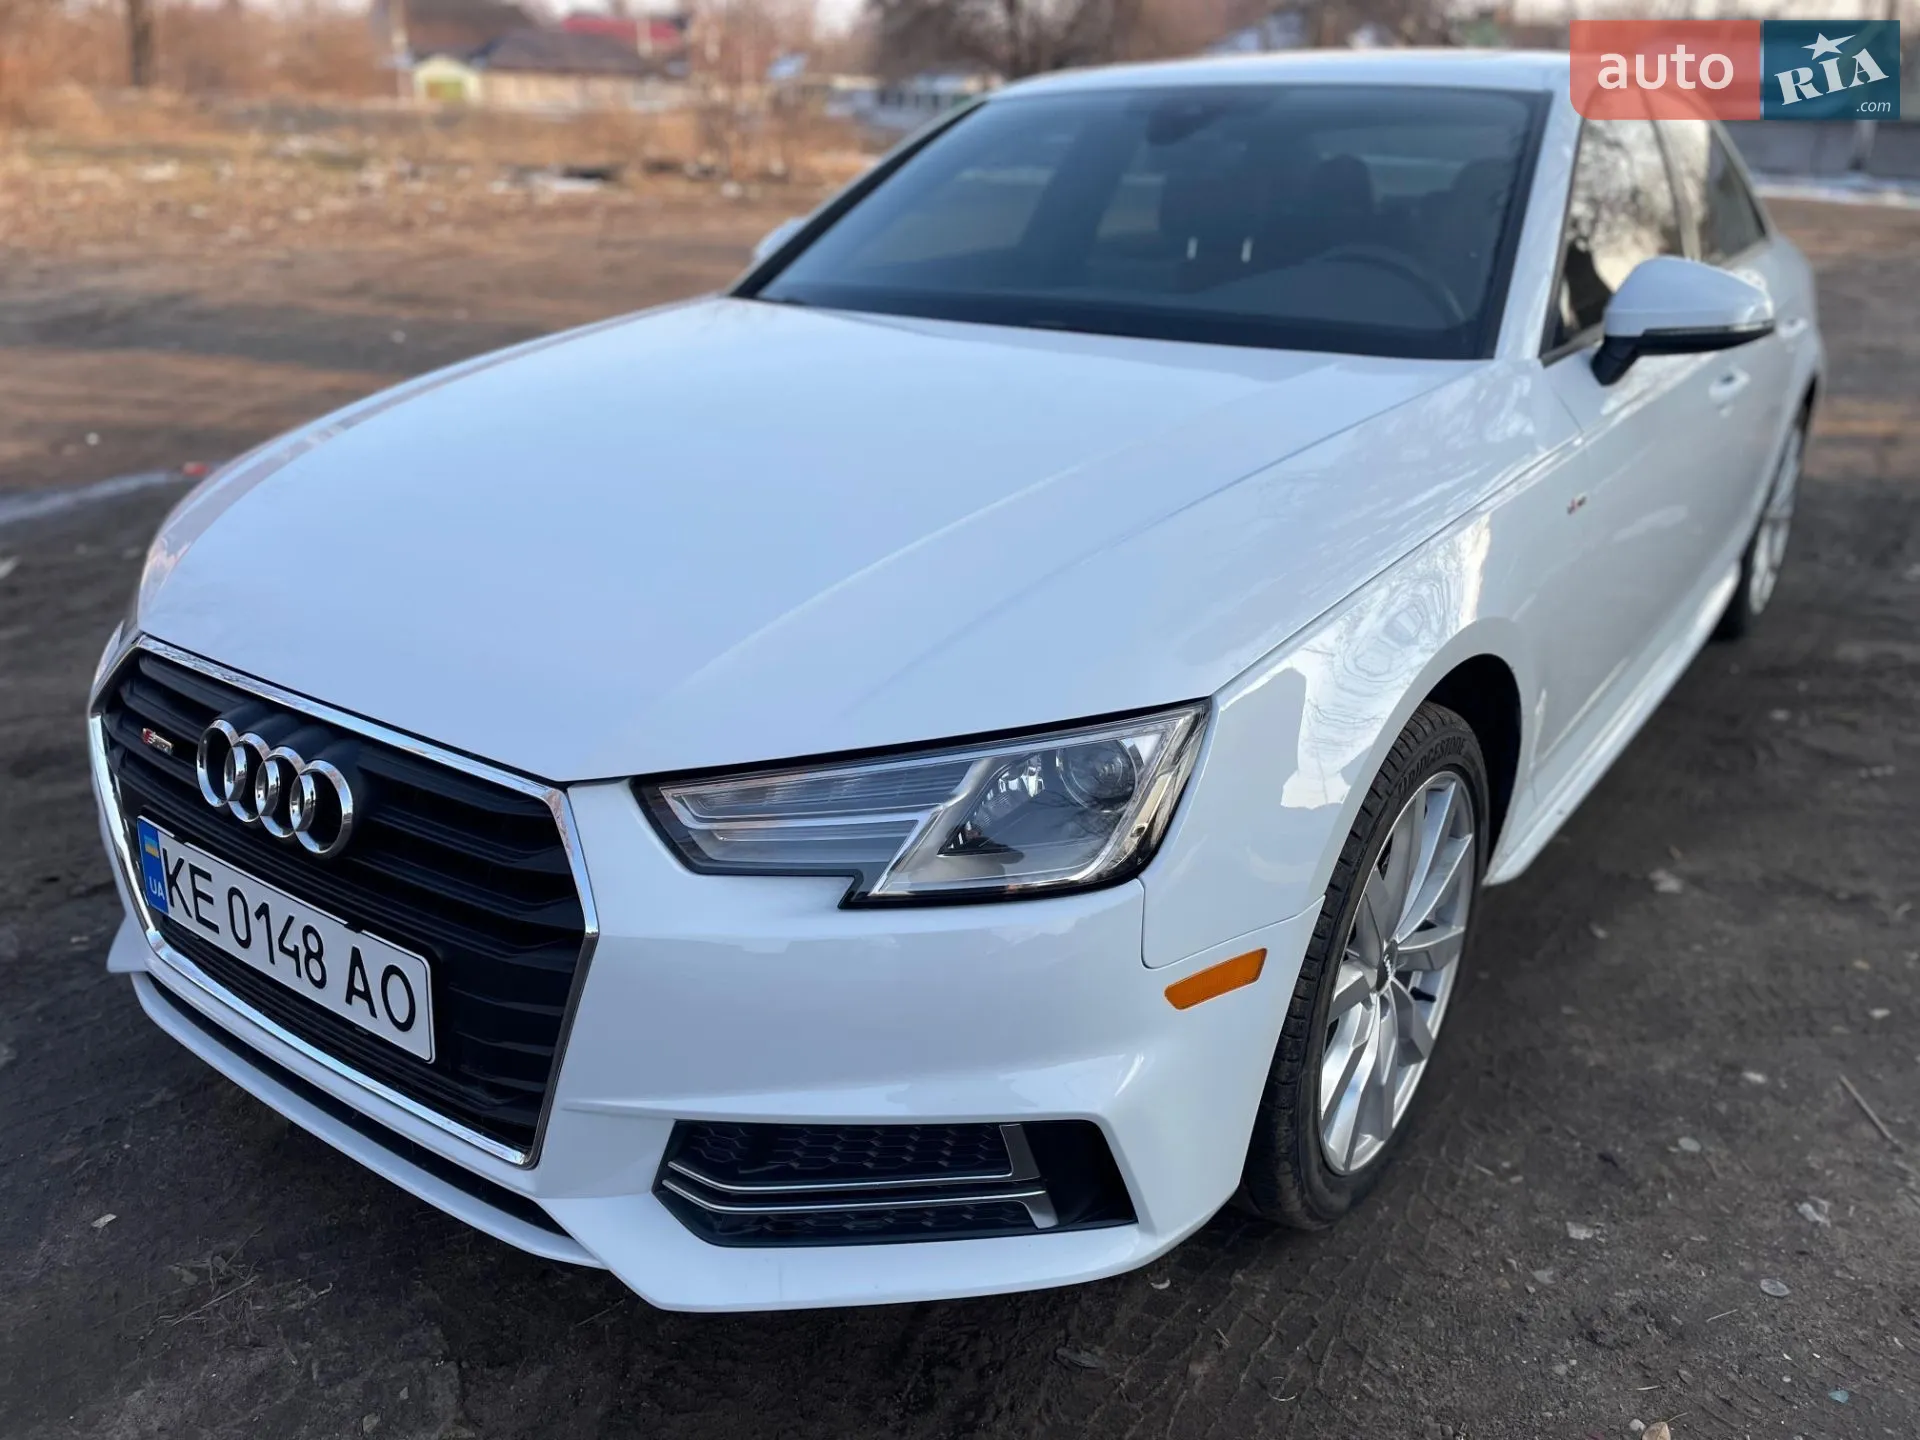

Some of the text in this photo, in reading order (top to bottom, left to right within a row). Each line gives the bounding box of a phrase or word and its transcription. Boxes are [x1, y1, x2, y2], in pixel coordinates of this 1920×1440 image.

[149, 875, 165, 900] UA
[162, 847, 416, 1032] KE 0148 AO
